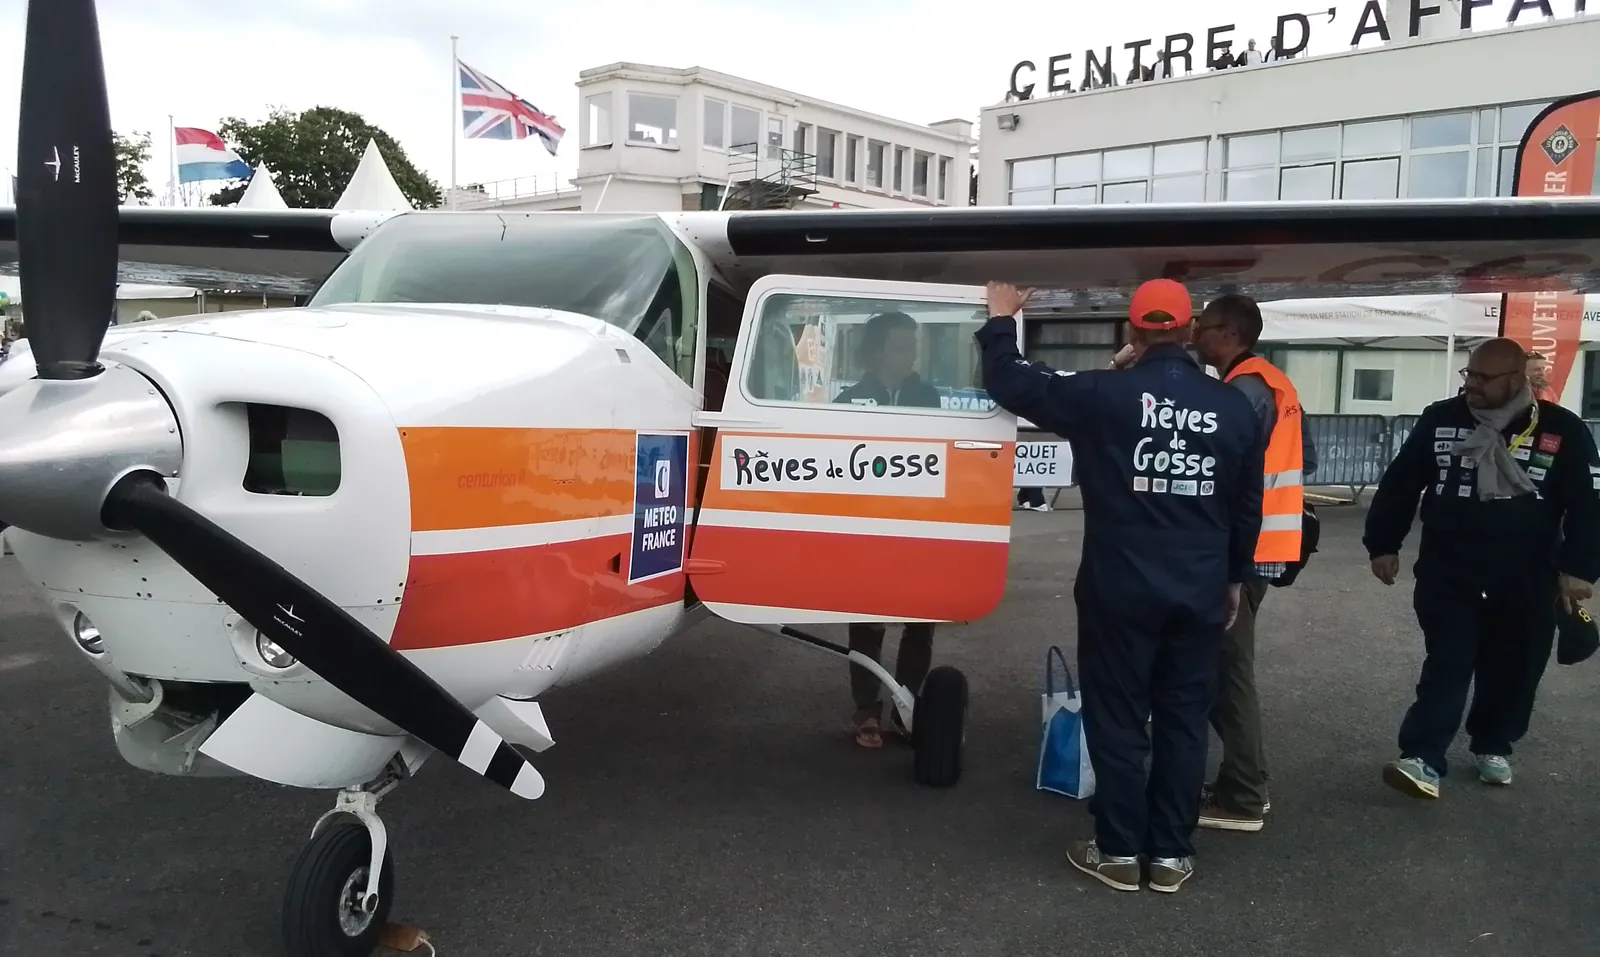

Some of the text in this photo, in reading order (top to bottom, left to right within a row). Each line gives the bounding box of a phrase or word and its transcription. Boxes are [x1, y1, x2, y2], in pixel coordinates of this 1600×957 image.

[1009, 0, 1587, 101] CENTRE D'AFFA
[1544, 171, 1568, 193] ER
[1484, 306, 1498, 317] LE
[1531, 291, 1558, 374] SAUVETE
[1139, 392, 1218, 434] Rêves
[1015, 444, 1058, 459] QUET
[1169, 430, 1187, 450] de
[732, 443, 940, 485] Rêves de Gosse
[1014, 462, 1057, 475] LAGE
[1133, 436, 1216, 477] Gosse
[643, 505, 677, 529] METEO
[642, 528, 676, 552] FRANCE
